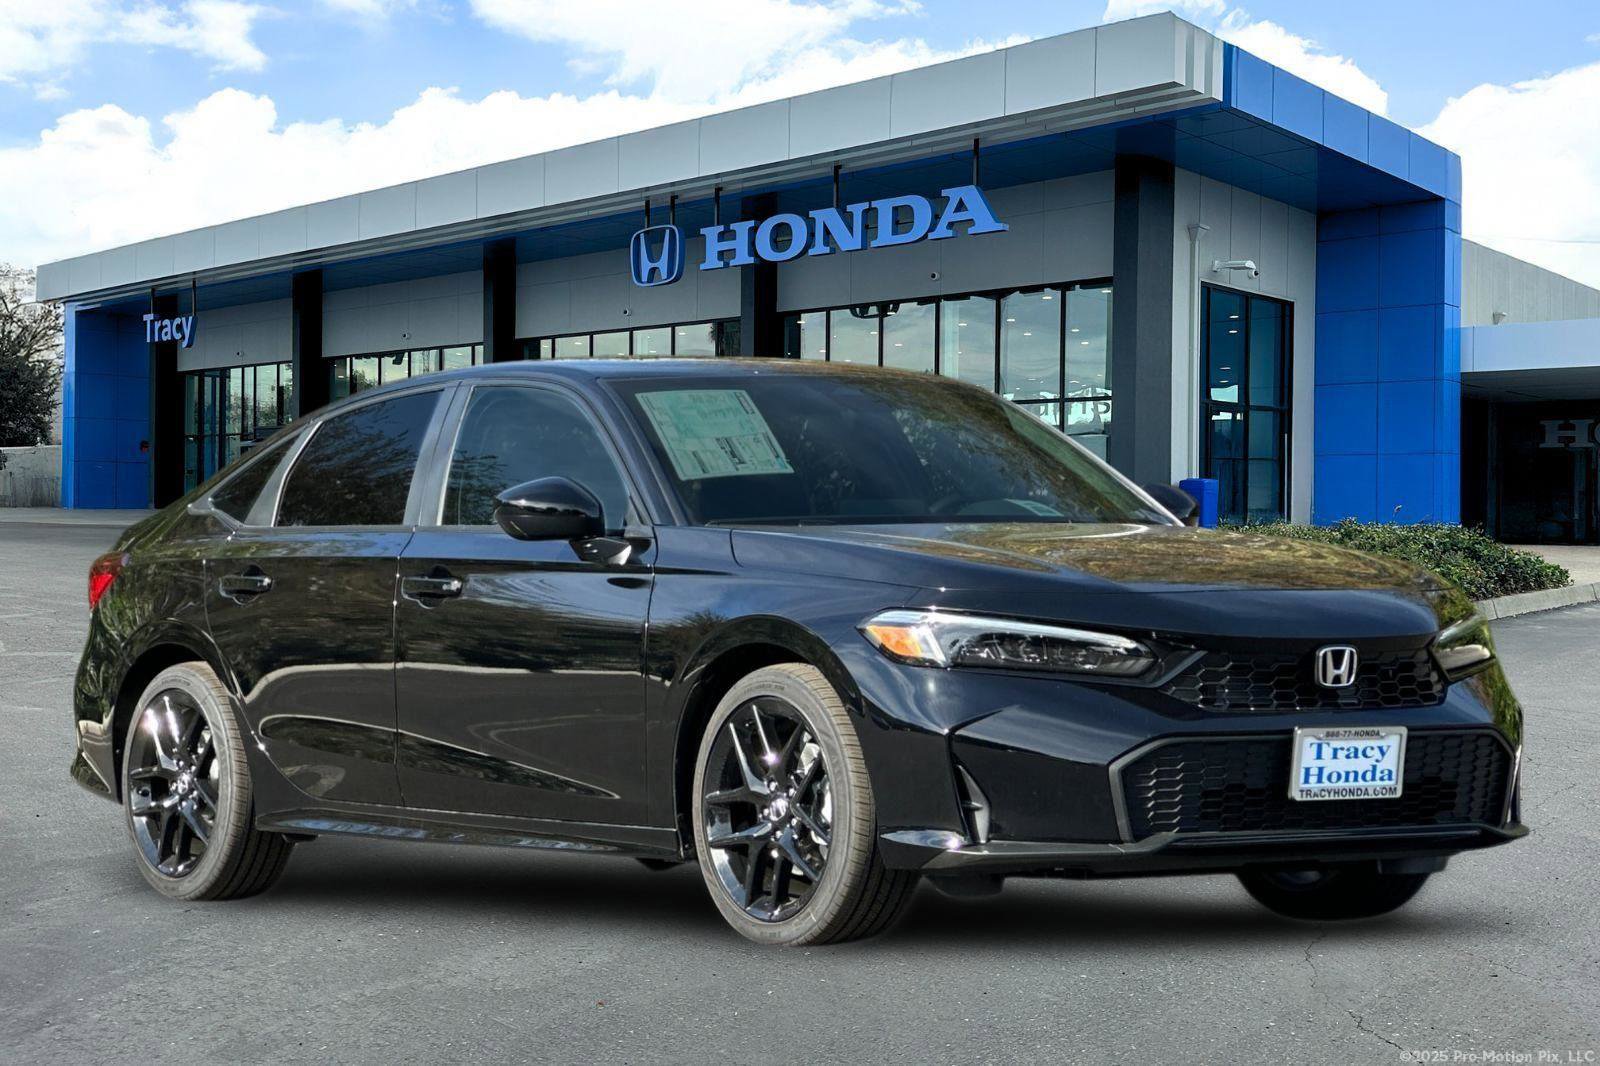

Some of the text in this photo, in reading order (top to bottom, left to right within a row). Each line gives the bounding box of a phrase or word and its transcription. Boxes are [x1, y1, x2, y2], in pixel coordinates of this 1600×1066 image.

[700, 184, 1009, 270] HONDA
[143, 313, 193, 348] Tracy
[1539, 419, 1600, 449] H
[1309, 742, 1391, 763] Tracy
[1302, 764, 1394, 784] Honda
[1299, 787, 1397, 799] TRACYHONDA.COM
